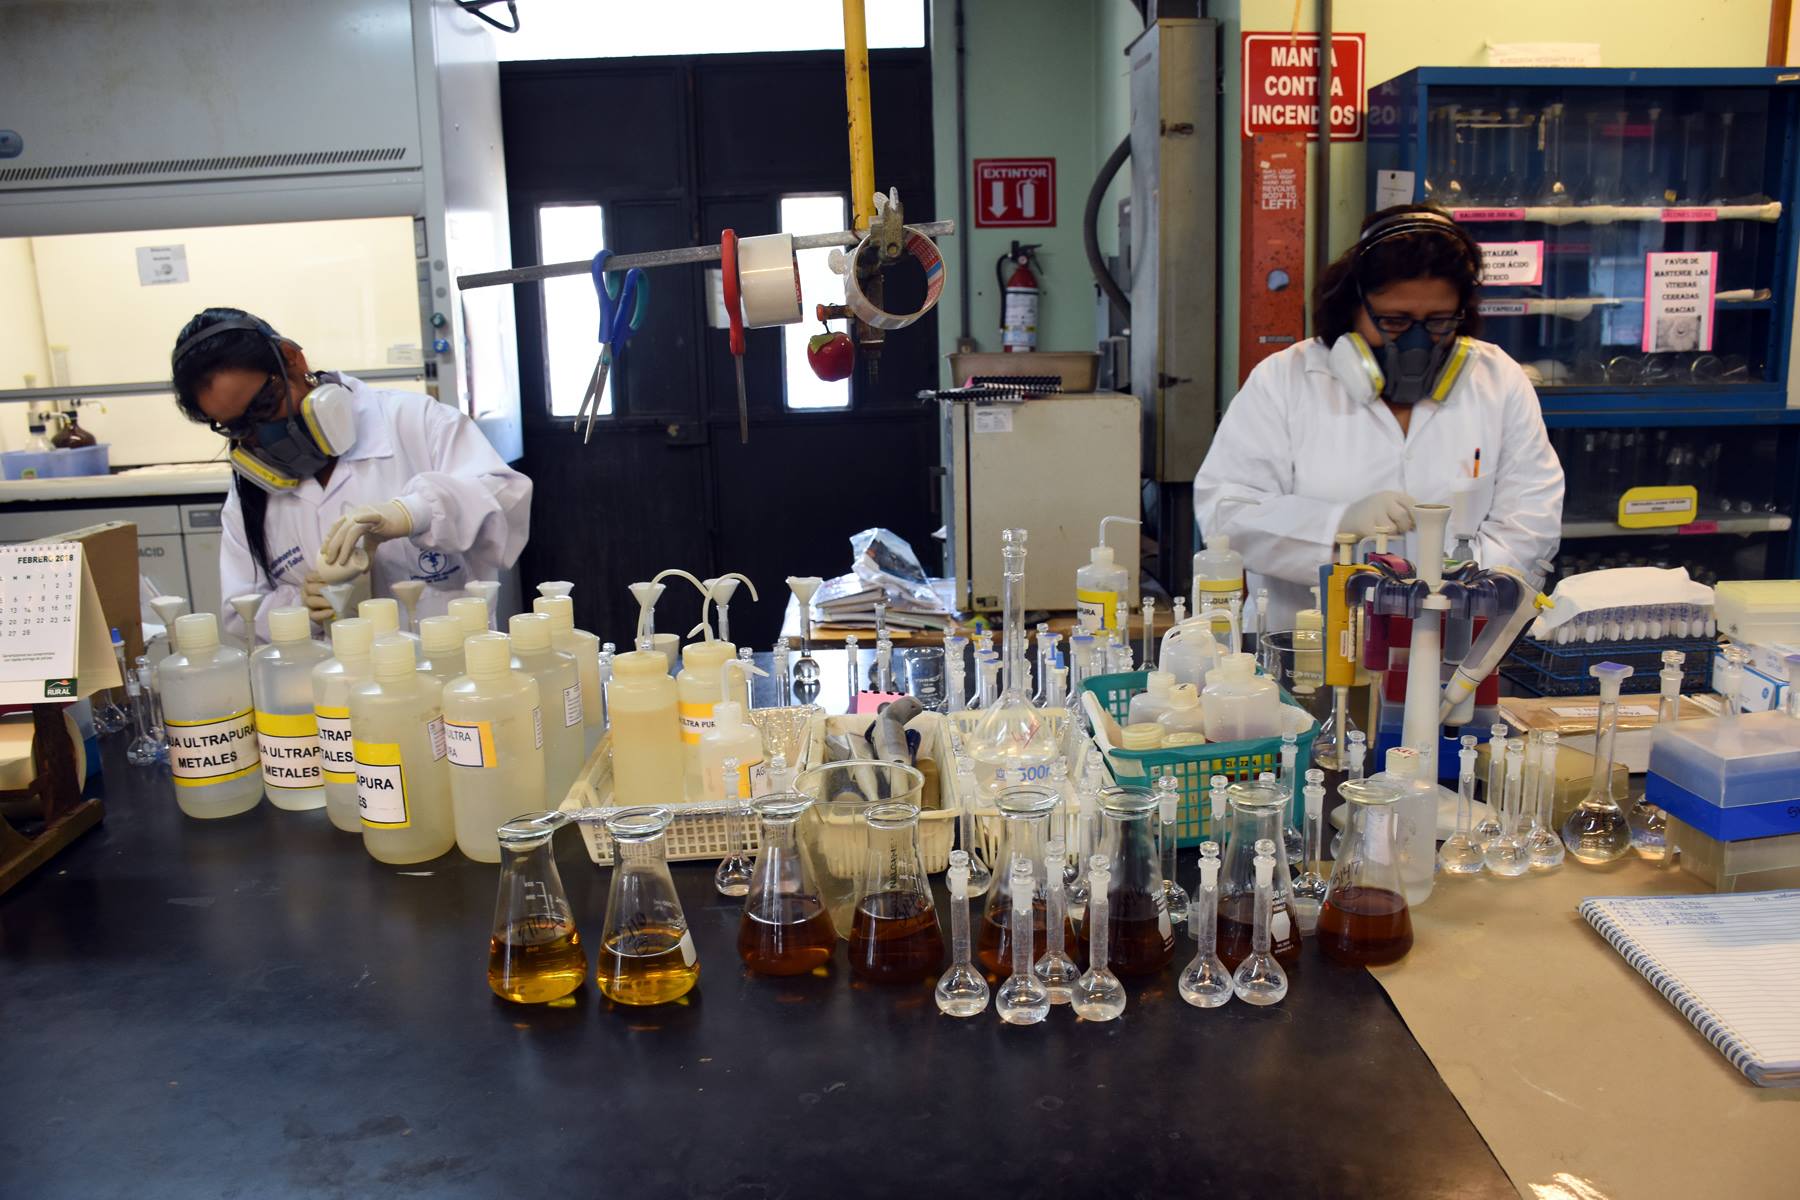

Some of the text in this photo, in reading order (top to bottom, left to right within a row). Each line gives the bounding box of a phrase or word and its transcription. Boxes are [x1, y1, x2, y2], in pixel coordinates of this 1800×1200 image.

[1264, 75, 1343, 96] CONTA
[1251, 104, 1355, 125] INCENDOS
[983, 168, 1047, 178] EXTINTOR
[1262, 199, 1296, 209] LEFT!
[1482, 249, 1518, 257] STALERÍA
[47, 688, 71, 696] RURAL
[184, 725, 255, 748] ULTRAPURA
[178, 752, 238, 769] METALES
[265, 765, 320, 778] METALES
